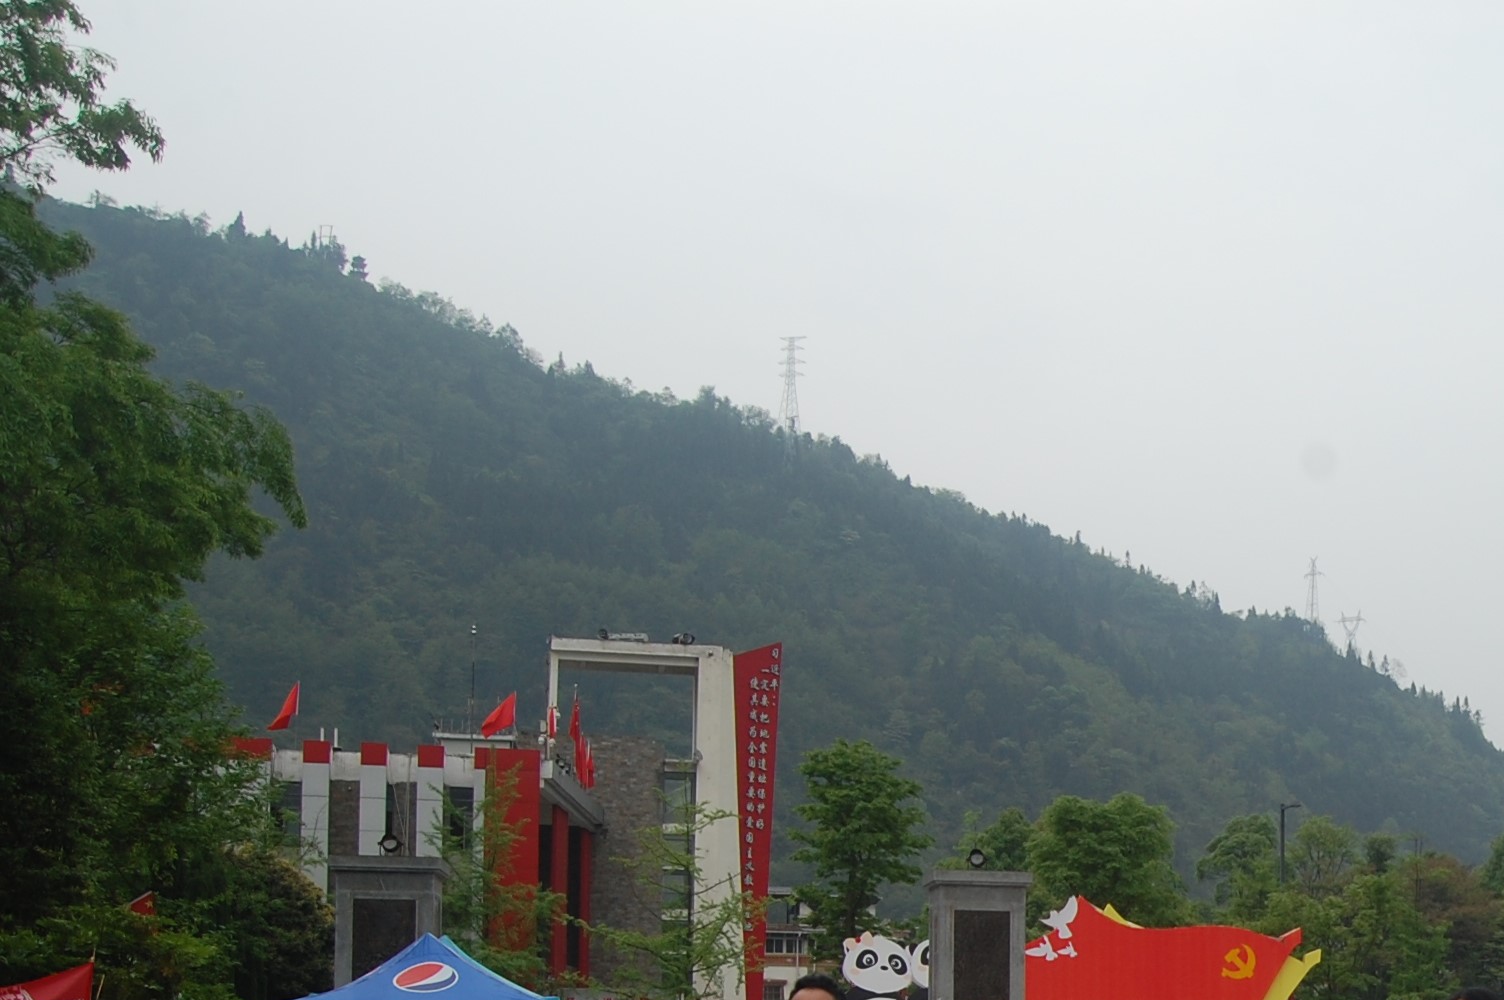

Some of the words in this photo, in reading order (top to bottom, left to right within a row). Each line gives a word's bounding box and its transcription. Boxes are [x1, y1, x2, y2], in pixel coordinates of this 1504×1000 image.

[743, 677, 760, 932] 使其成为全国重要的爱国主义教地
